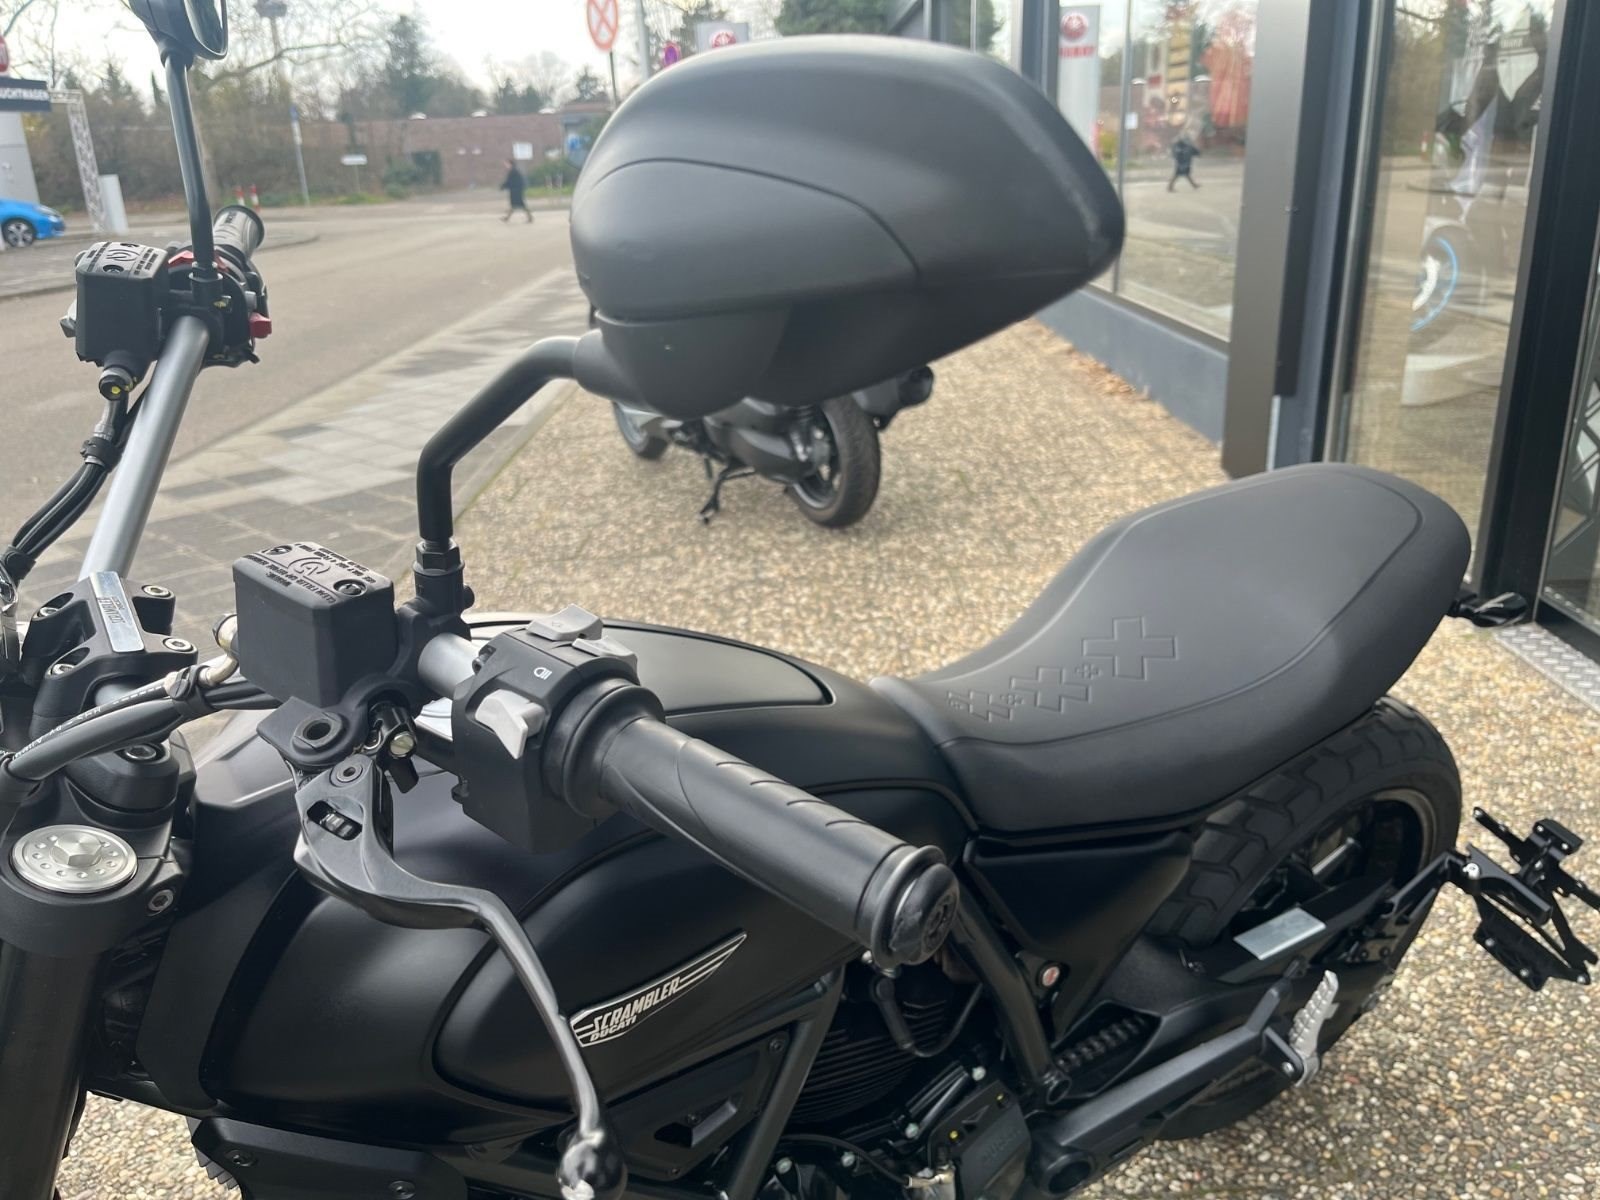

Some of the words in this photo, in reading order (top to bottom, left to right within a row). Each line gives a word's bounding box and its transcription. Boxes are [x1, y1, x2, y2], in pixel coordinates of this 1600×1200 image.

[297, 579, 319, 592] FILLER
[315, 589, 336, 604] CLEAN
[592, 976, 680, 1033] SCRAMBLER
[590, 1015, 637, 1041] DUCATI
